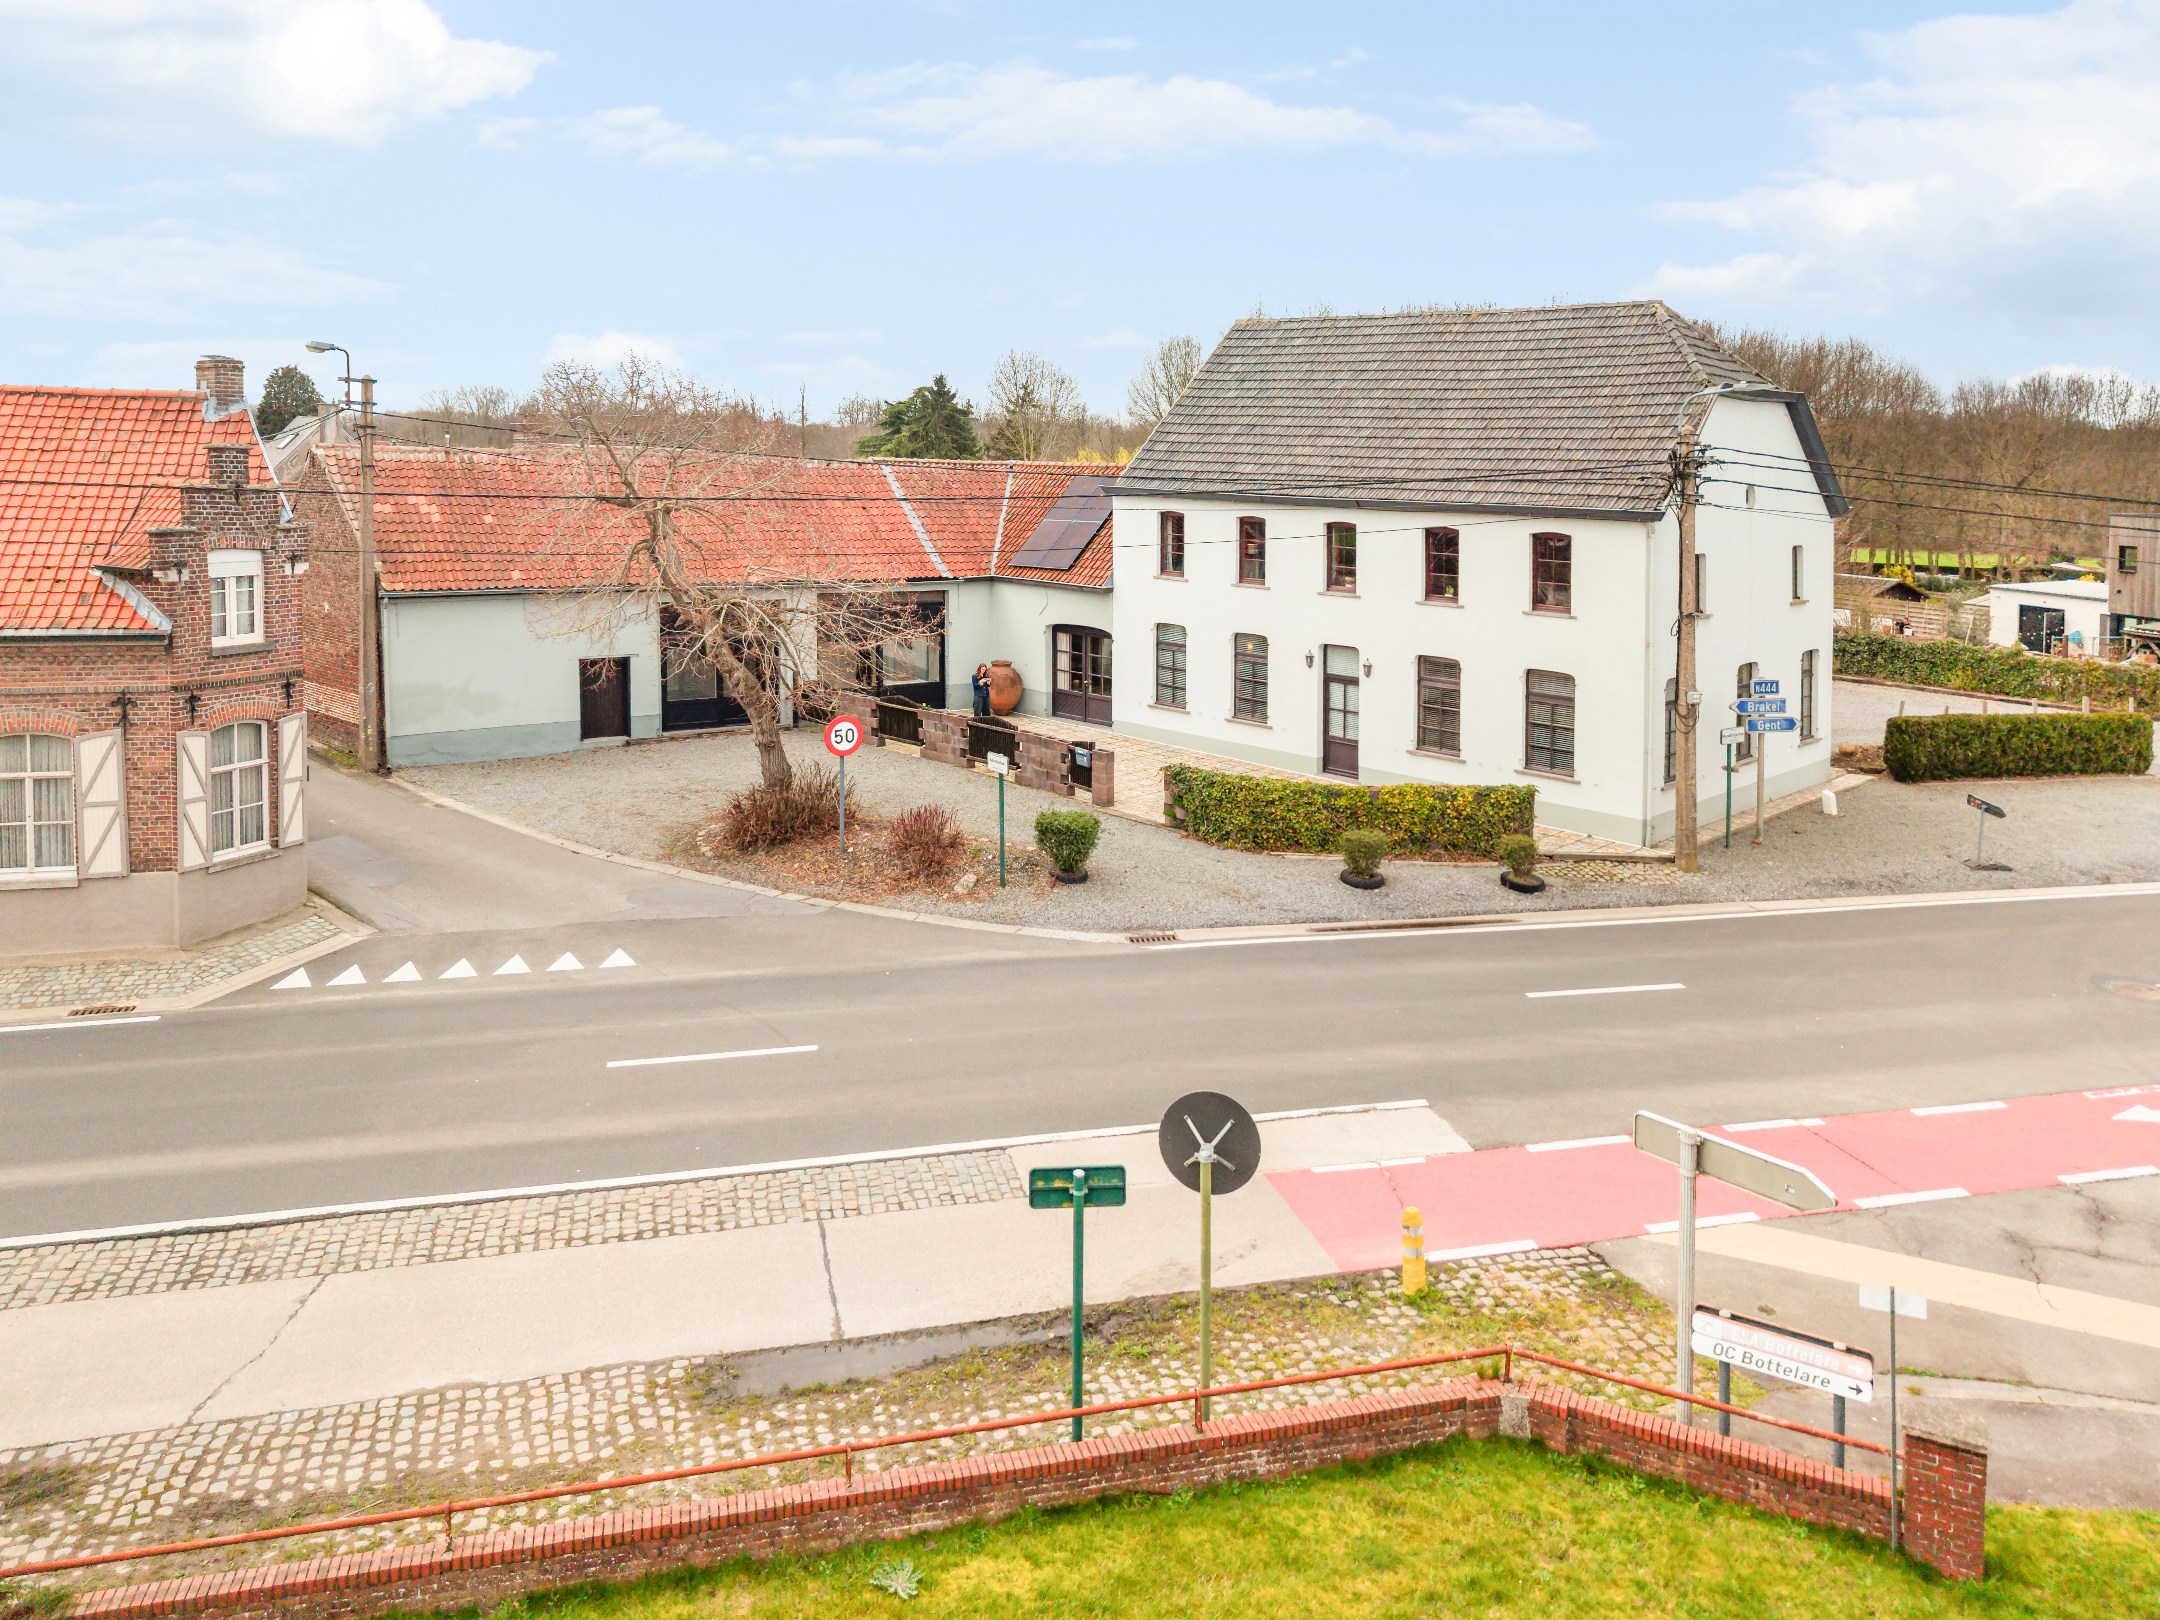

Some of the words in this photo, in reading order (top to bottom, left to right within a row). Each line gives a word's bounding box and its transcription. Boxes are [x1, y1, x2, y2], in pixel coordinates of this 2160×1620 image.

[1755, 683, 1777, 693] N444
[1747, 701, 1780, 712] Brakel
[1757, 720, 1781, 731] Gent
[834, 728, 855, 744] 50
[1765, 1339, 1840, 1371] Bottelare
[1712, 1342, 1736, 1360] OC
[1741, 1350, 1831, 1388] Bottelare
